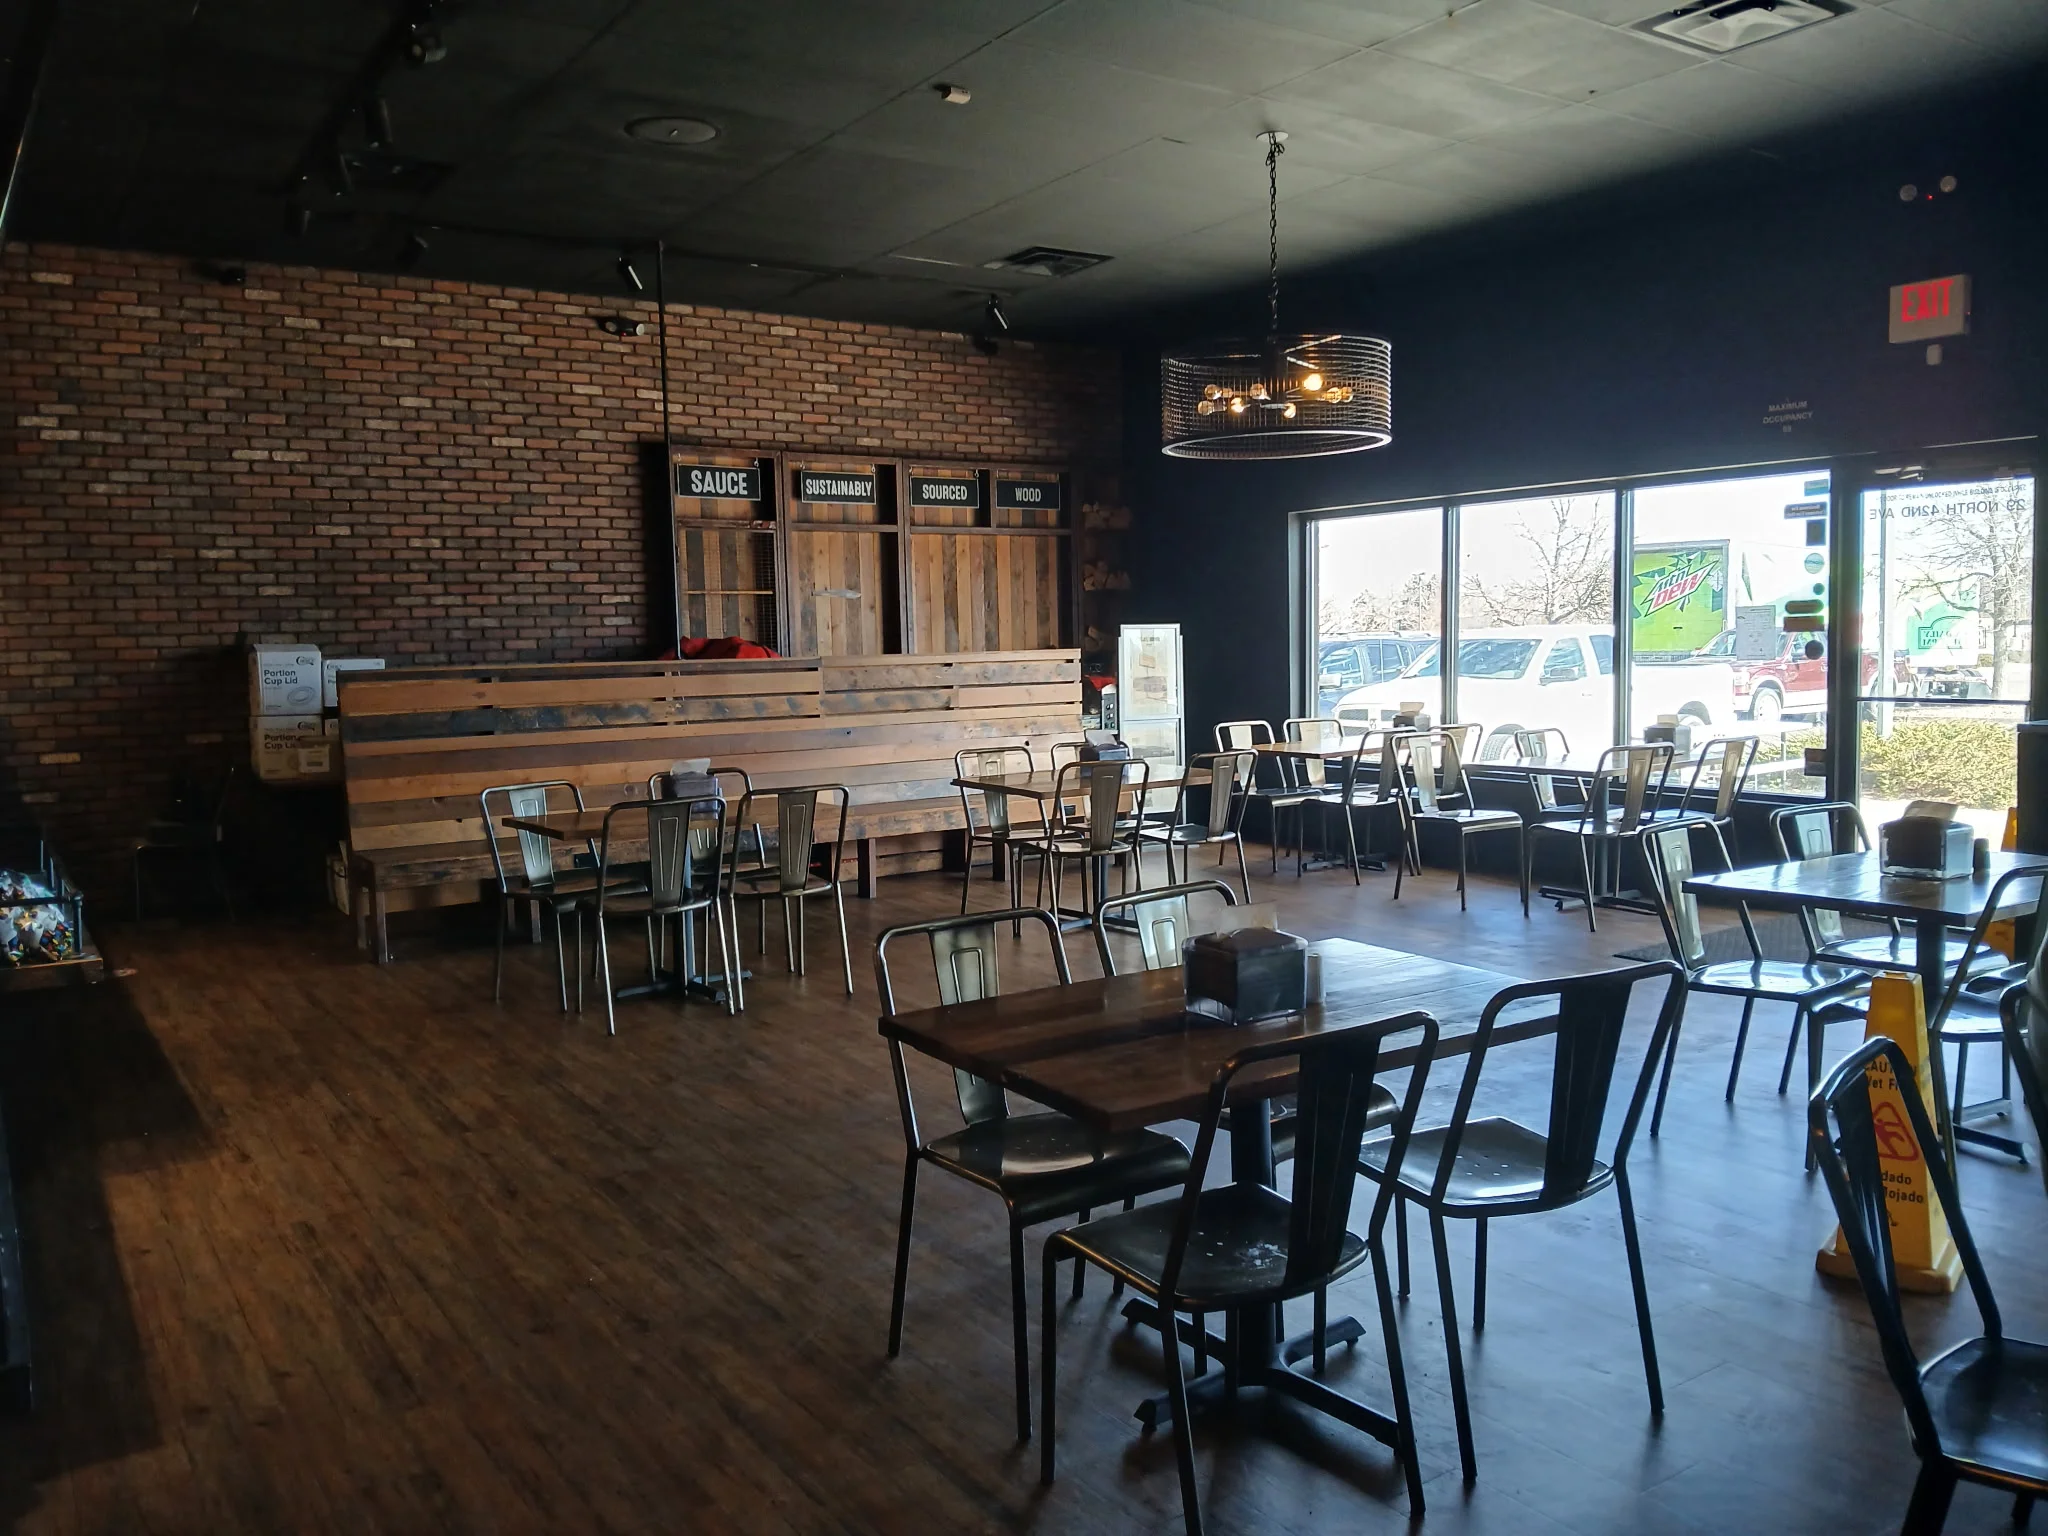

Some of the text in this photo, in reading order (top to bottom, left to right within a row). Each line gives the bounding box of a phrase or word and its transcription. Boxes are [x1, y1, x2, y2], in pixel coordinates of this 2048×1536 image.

[1901, 278, 1954, 323] EXIT
[1767, 400, 1808, 413] MAXIMUM
[1762, 410, 1814, 425] OCCUPANCY
[690, 469, 748, 495] SAUCE
[805, 478, 872, 497] SUSTAINABLY
[922, 483, 968, 500] SOURCED
[1015, 487, 1042, 502] WOOD
[264, 669, 296, 677] Portion
[264, 677, 298, 686] Cup Lid
[264, 734, 297, 742] Portion
[264, 741, 283, 750] Cup
[1881, 1170, 1912, 1185] dado
